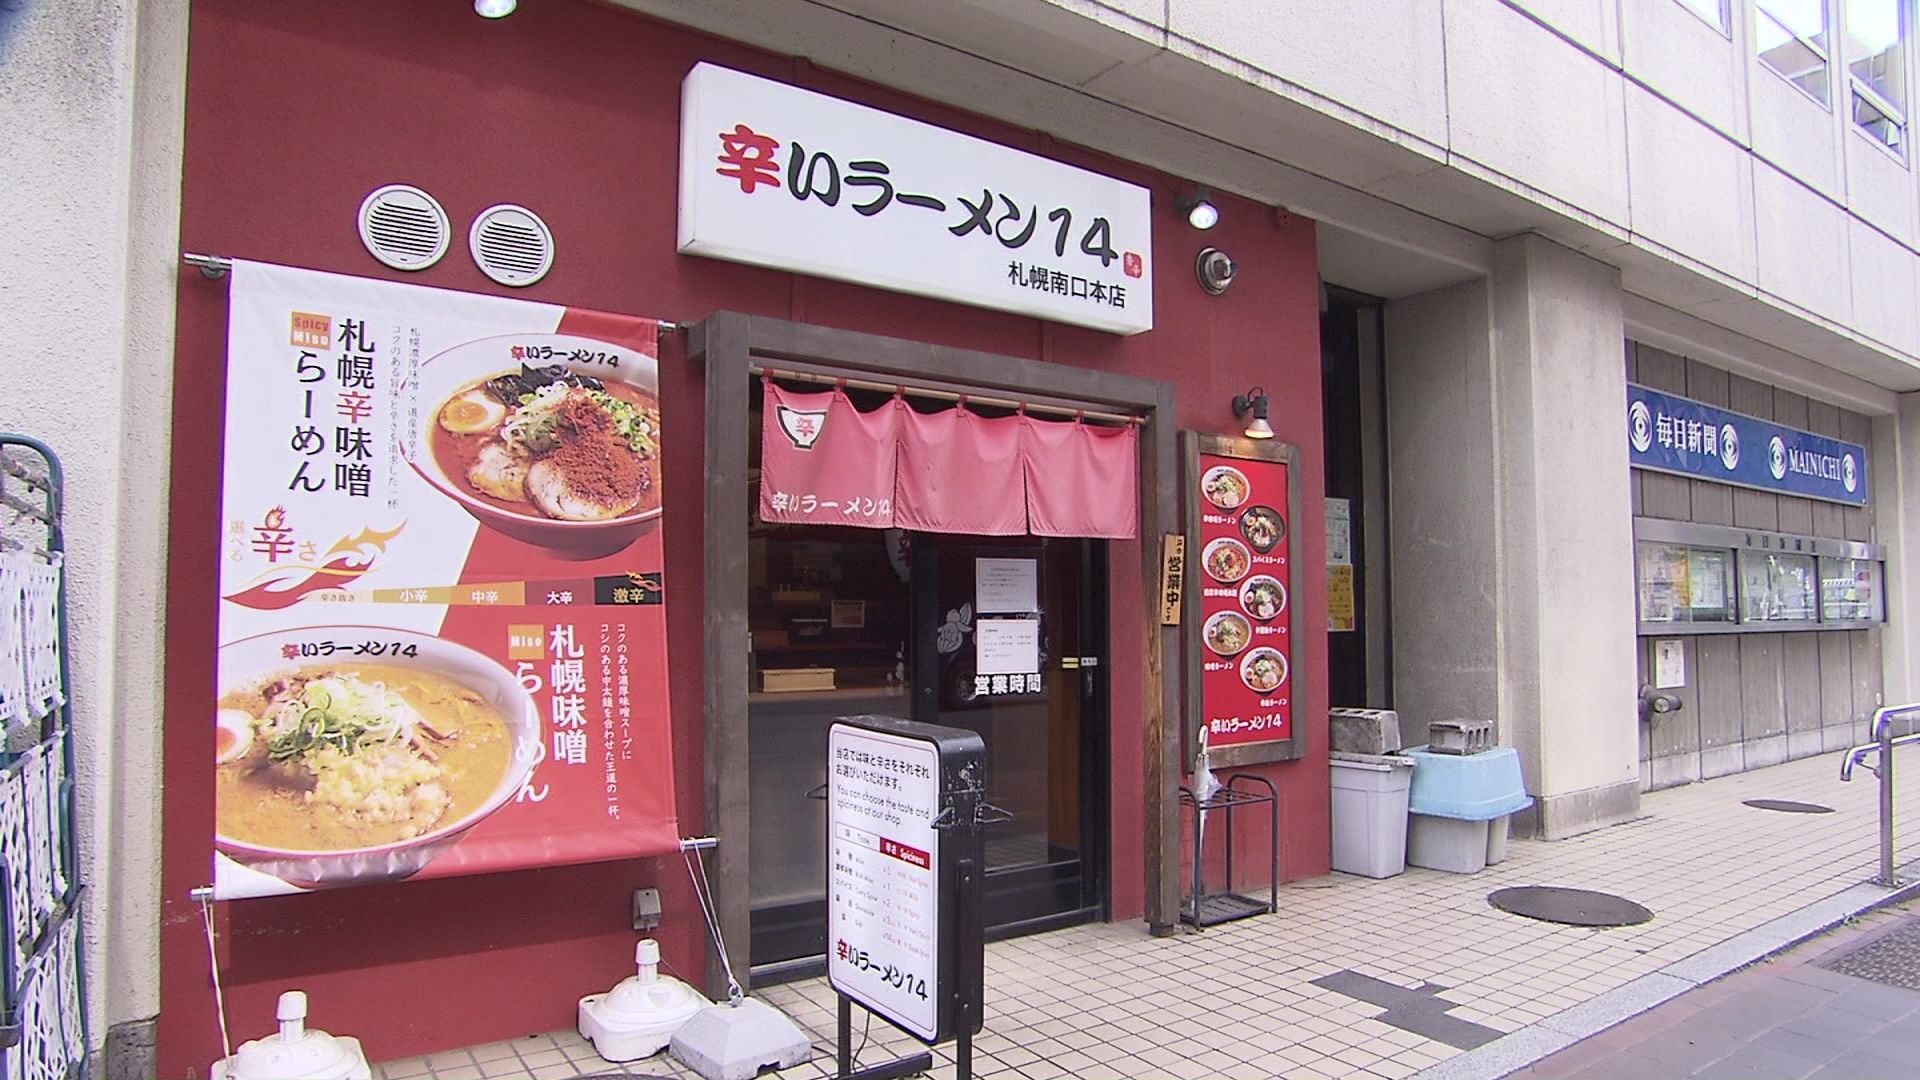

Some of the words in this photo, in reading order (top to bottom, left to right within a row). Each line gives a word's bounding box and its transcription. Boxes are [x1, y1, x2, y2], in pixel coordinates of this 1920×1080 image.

[716, 124, 1118, 267] 辛いラーメン14
[1008, 260, 1126, 309] 札幌南口本店
[294, 317, 329, 332] Spicy
[293, 331, 329, 345] Miso
[511, 346, 620, 368] 辛いラーメン14
[335, 318, 376, 497] 札幌辛味噌
[288, 350, 326, 492] らーめん
[796, 417, 815, 437] 辛
[1656, 412, 1717, 457] 毎日新聞
[1788, 448, 1842, 481] MAINICHI
[1166, 556, 1182, 607] 営業中
[400, 587, 428, 603] 小辛
[471, 590, 498, 604] 中辛
[547, 591, 573, 605] 大辛
[613, 587, 645, 604] 激辛
[281, 641, 418, 659] 辛いラーメン14
[511, 635, 542, 647] Miso
[550, 624, 587, 764] 札幌味噌
[974, 674, 1041, 696] 営業時間
[515, 661, 549, 803] らーめん
[1210, 713, 1283, 734] 辛いラーメン14
[836, 938, 928, 1001] 辛いラーメン14
